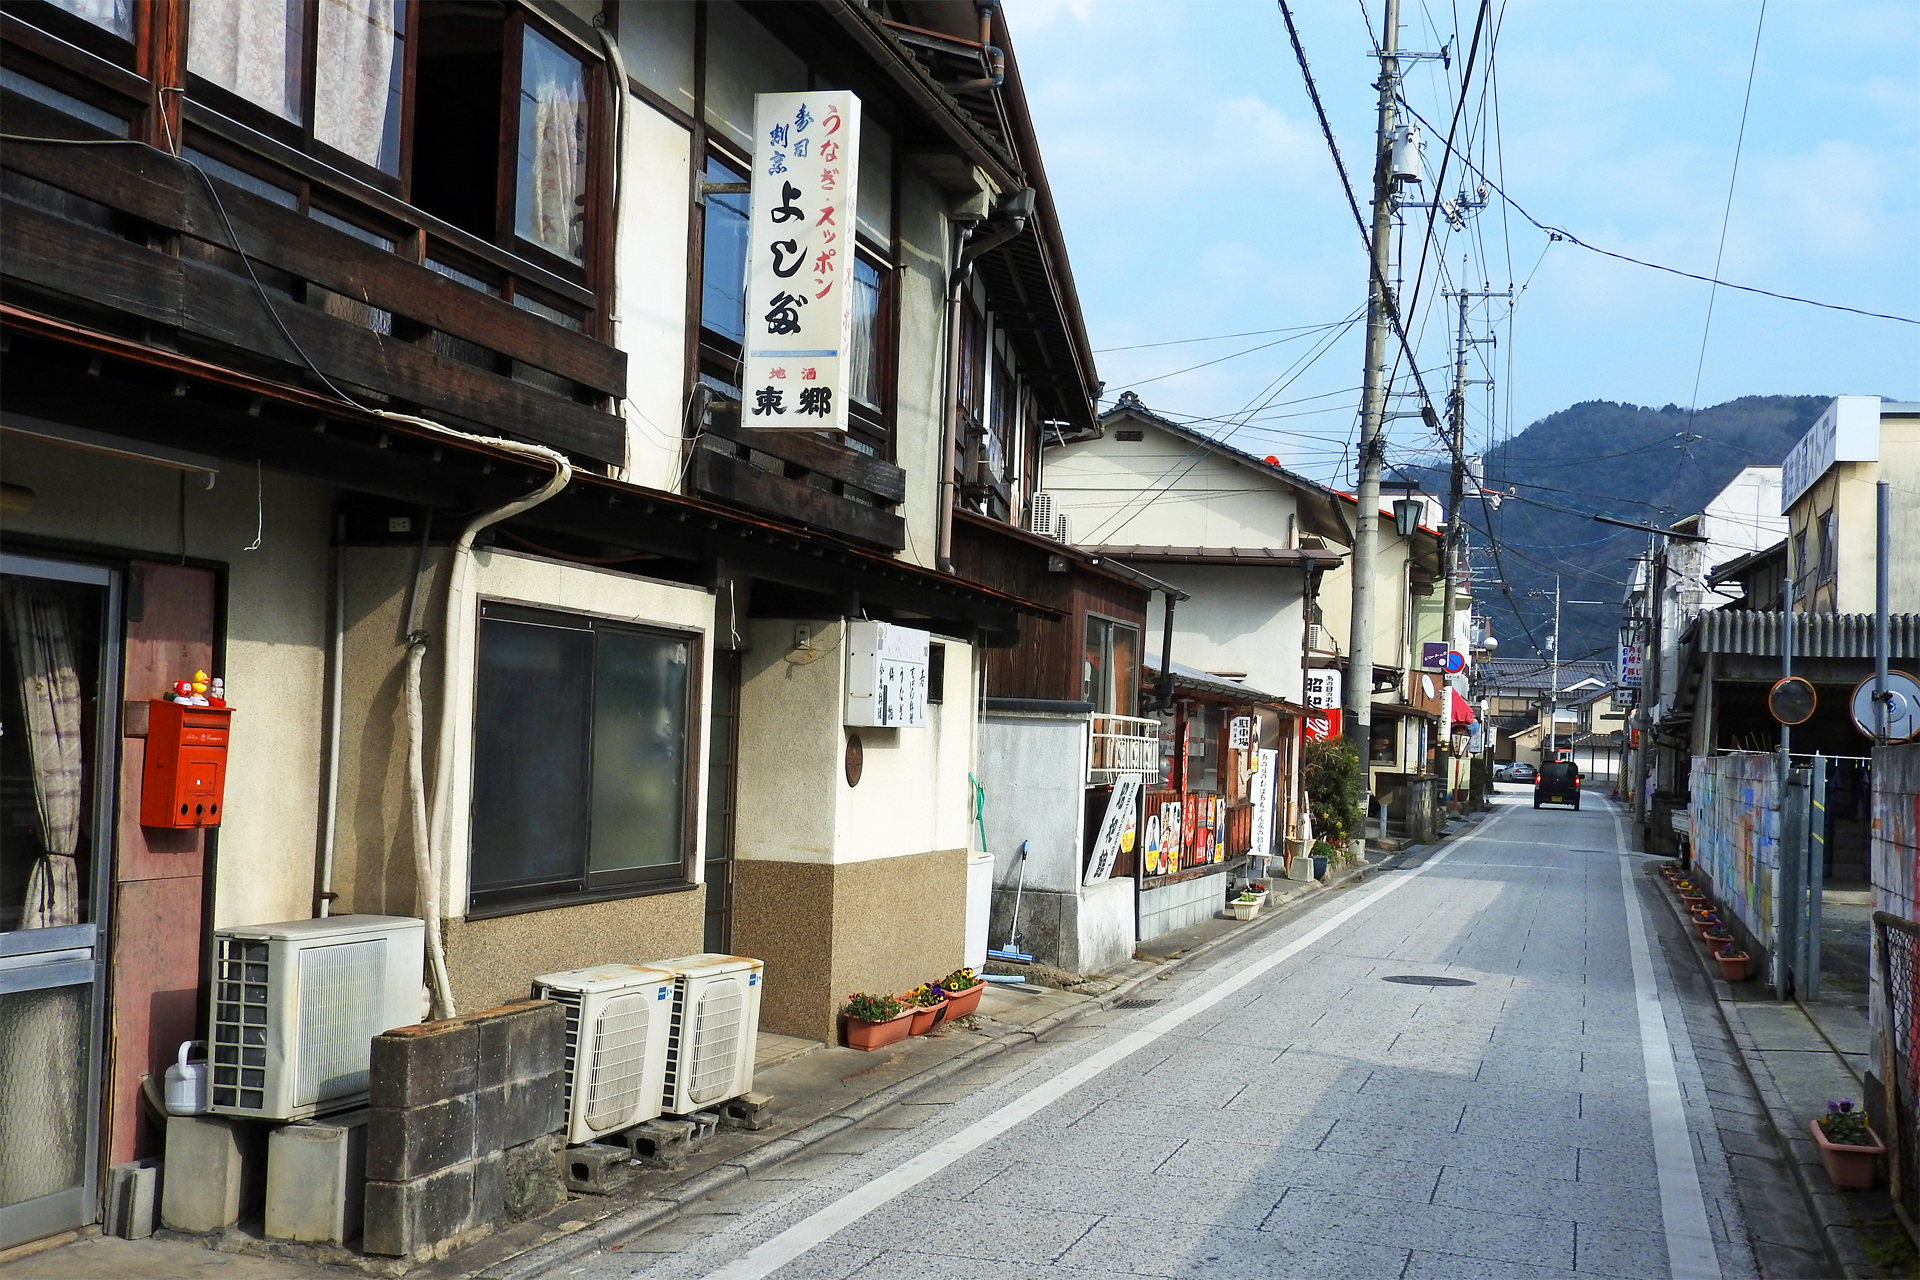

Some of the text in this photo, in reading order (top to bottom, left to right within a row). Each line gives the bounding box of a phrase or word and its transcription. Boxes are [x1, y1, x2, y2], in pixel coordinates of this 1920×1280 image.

[768, 123, 789, 176] 割烹
[794, 102, 814, 158] 寿司
[814, 105, 841, 299] うなぎ・スッポン
[768, 367, 817, 381] 地酒
[751, 385, 832, 418] 東郷
